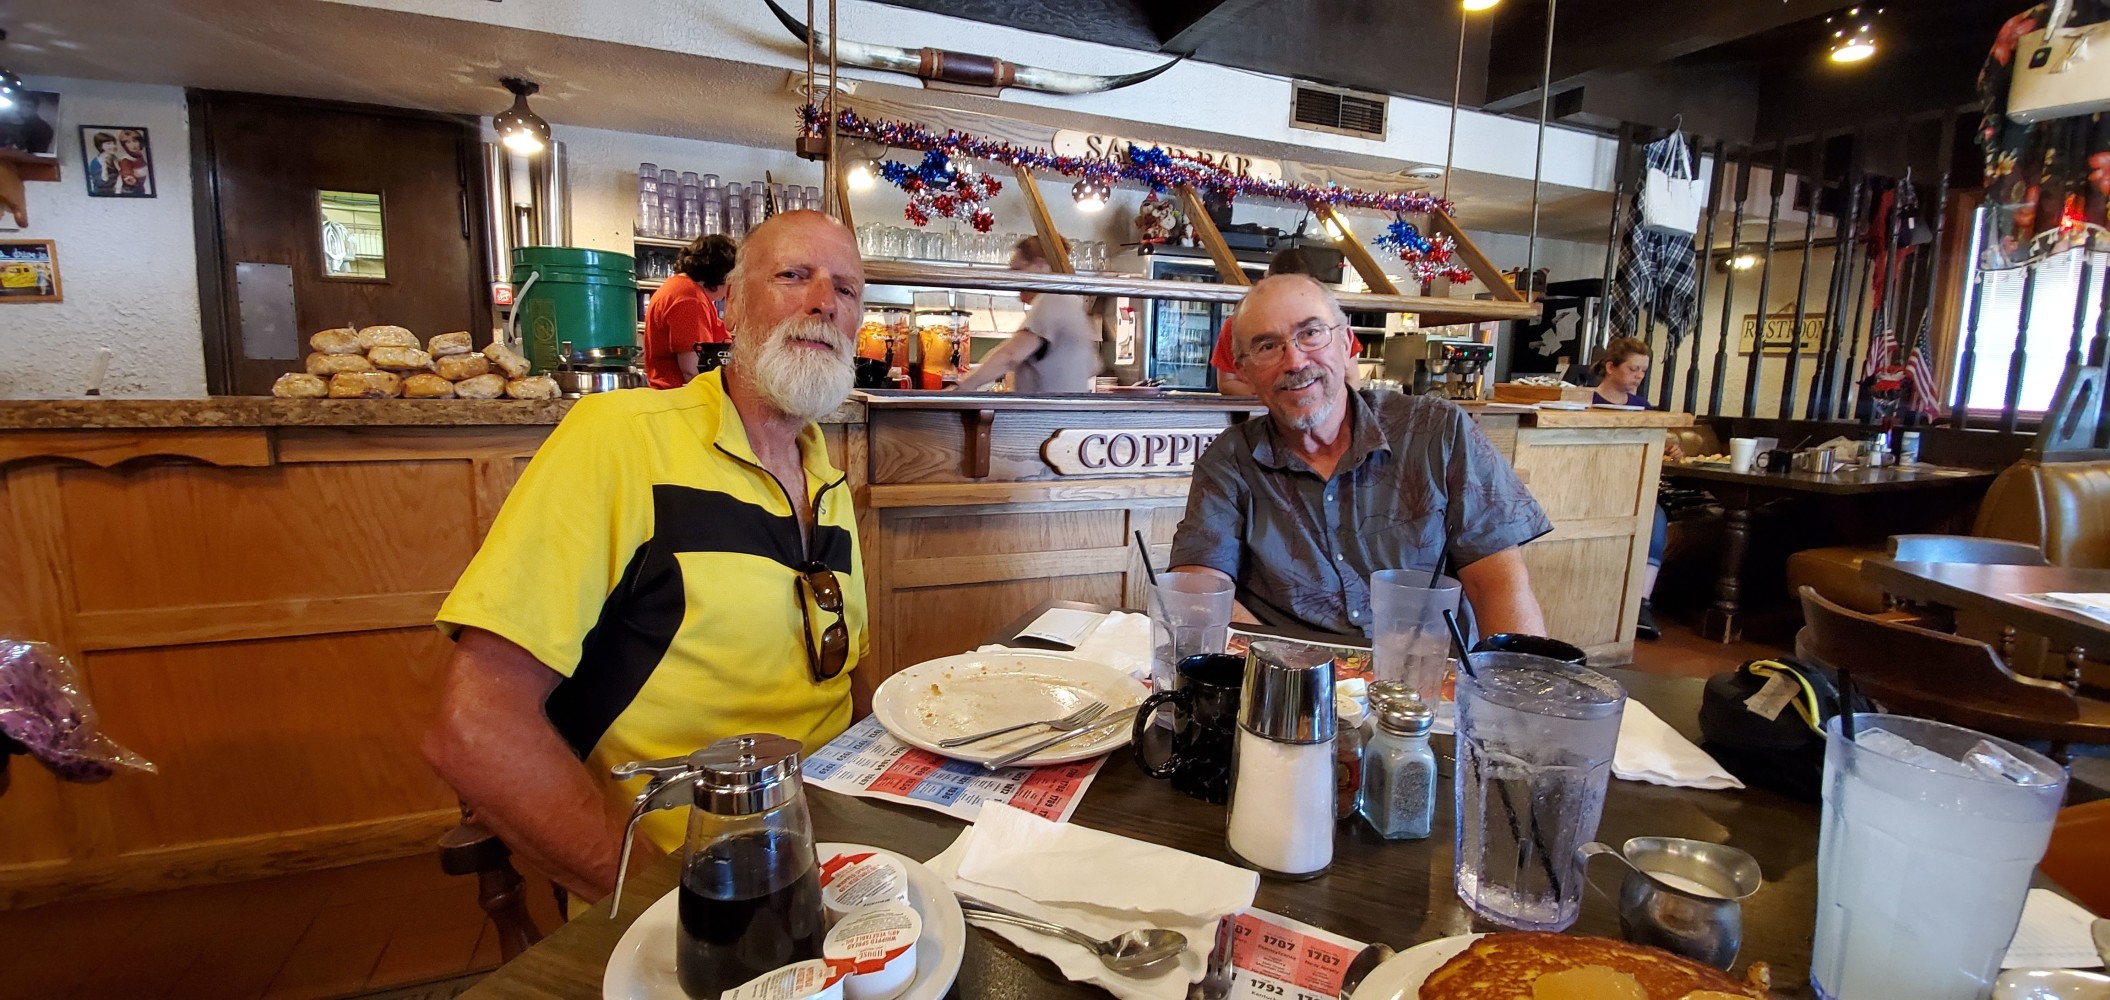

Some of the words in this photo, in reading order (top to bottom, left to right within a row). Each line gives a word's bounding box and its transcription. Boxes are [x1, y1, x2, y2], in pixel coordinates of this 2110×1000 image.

[1045, 794, 1059, 808] 1789
[1263, 934, 1296, 952] 1787
[1307, 949, 1341, 967] 1787
[1250, 978, 1285, 996] 1792
